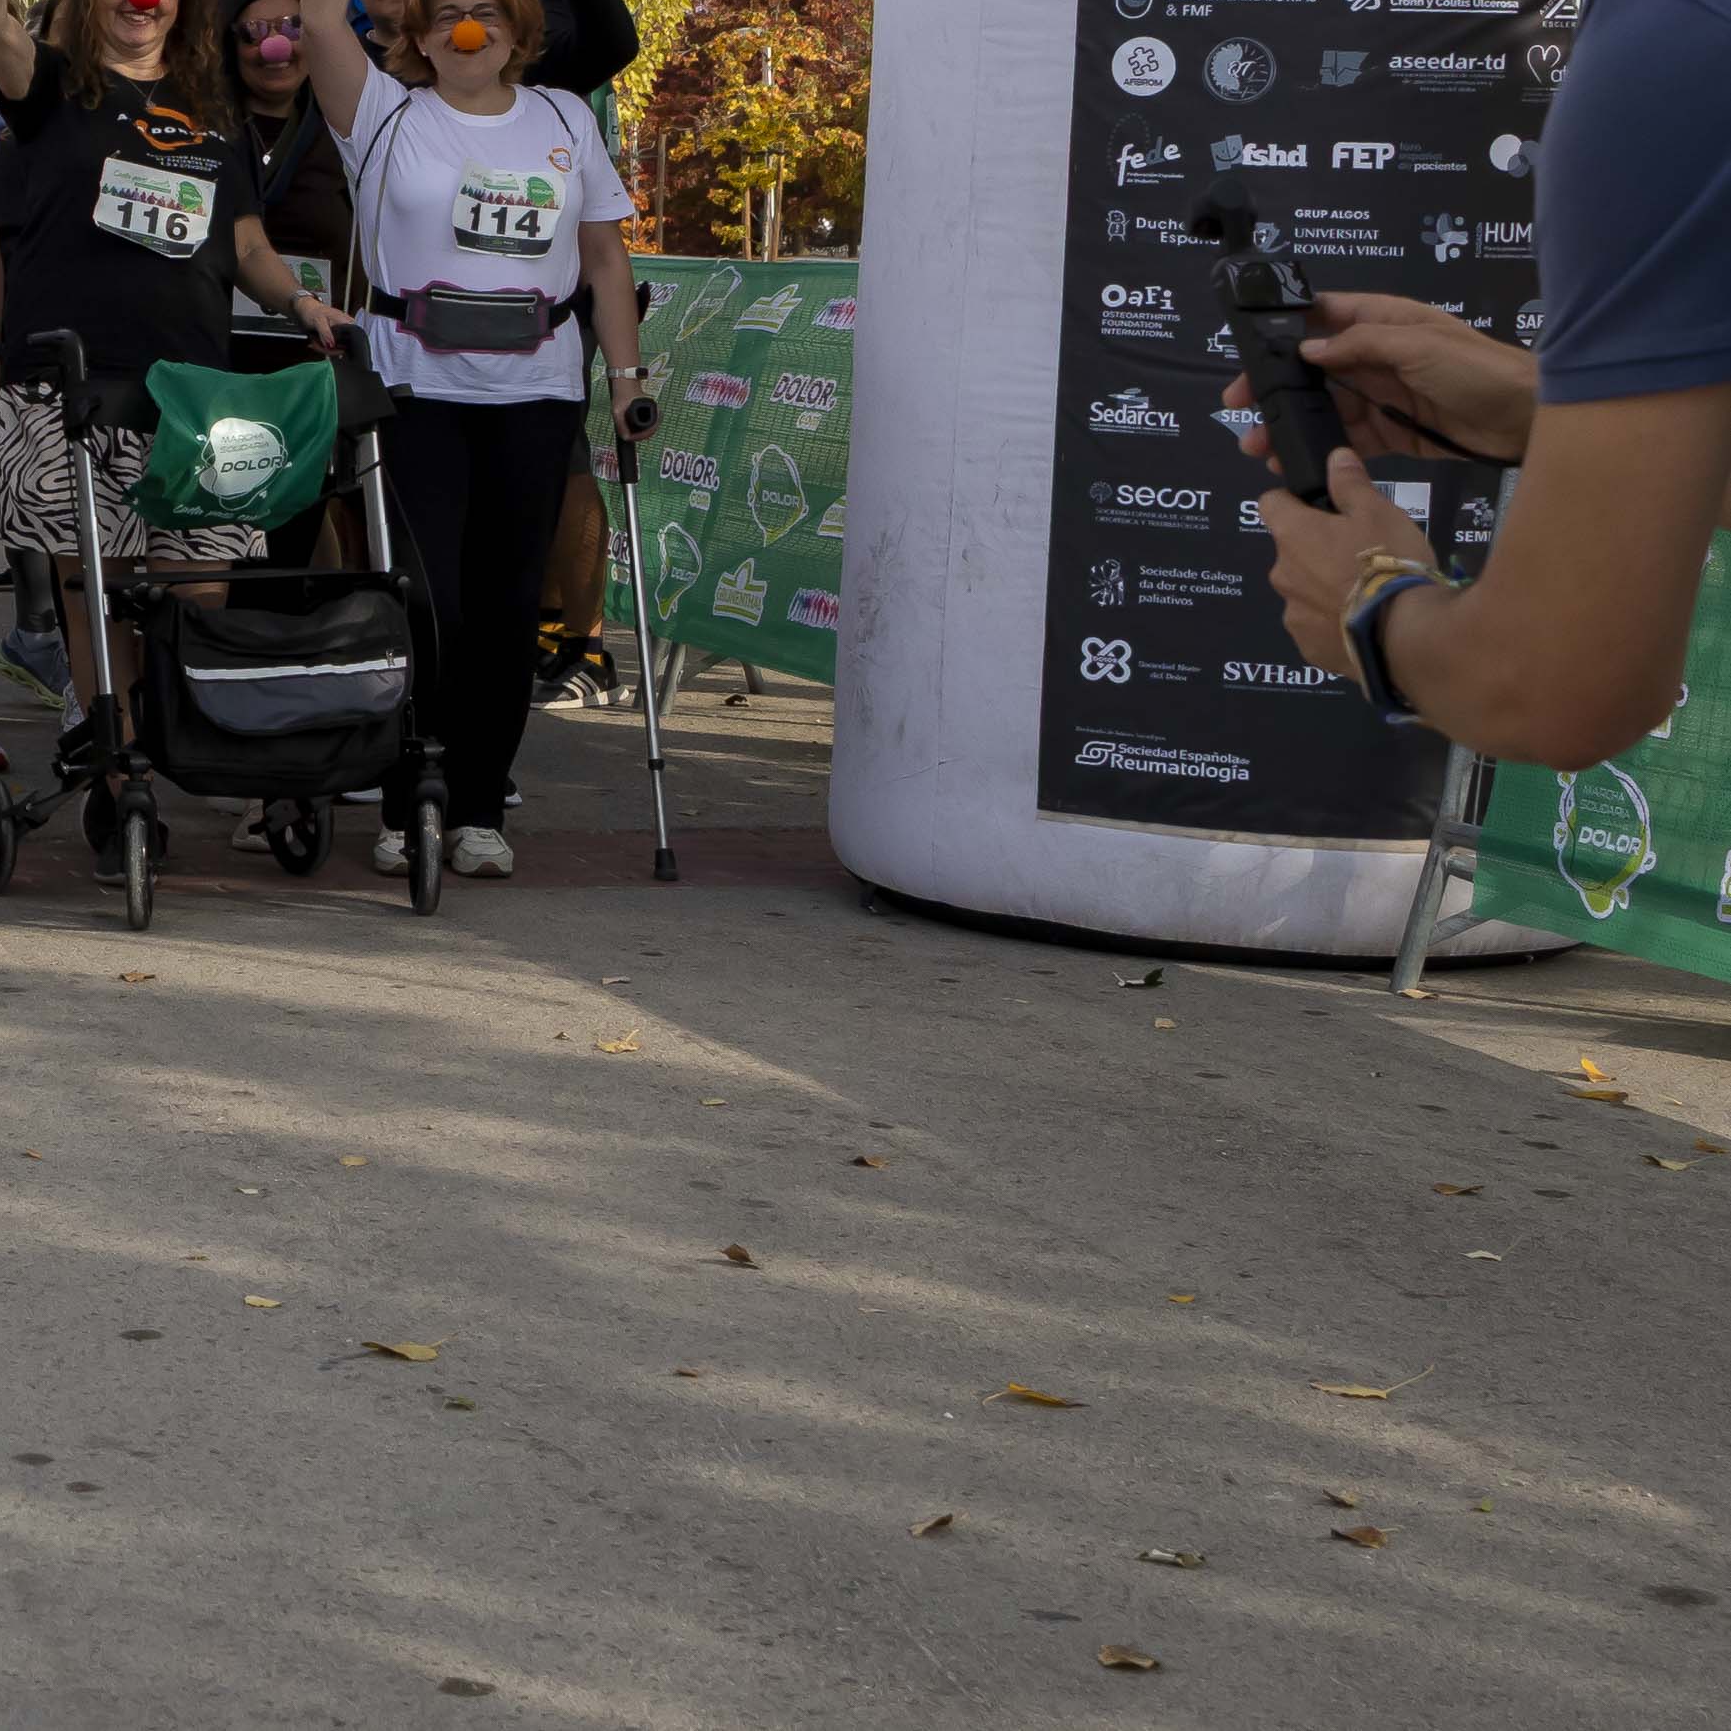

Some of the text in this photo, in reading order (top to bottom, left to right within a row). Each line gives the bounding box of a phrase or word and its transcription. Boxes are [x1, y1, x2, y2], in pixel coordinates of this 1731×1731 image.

[1166, 4, 1213, 16] & FMF
[1426, 0, 1433, 9] y
[1389, 52, 1507, 71] aseedar-td
[1117, 136, 1181, 187] fede
[1242, 143, 1308, 168] fshd
[1332, 141, 1395, 170] FEP
[1414, 162, 1468, 173] pacientes
[117, 201, 190, 241] 116
[470, 203, 541, 238] 114
[1294, 209, 1370, 220] GRUP ALGOS
[1294, 228, 1380, 240] UNIVERSITAT
[1293, 243, 1345, 255] ROVIRA
[1356, 245, 1405, 257] VIRGILI
[1101, 319, 1163, 330] FOUNDATION
[1102, 310, 1181, 322] OSTEOARTHRITIS
[1474, 316, 1492, 328] del
[1100, 327, 1175, 339] INTERNATIONAL
[220, 455, 284, 473] DOLOR
[762, 489, 800, 508] DOLOR
[1454, 530, 1491, 543] SEM
[1139, 565, 1243, 584] Sociedade Galega
[1139, 580, 1155, 590] da
[1156, 581, 1176, 592] dor
[1189, 583, 1243, 597] coidados
[1138, 594, 1194, 607] paliativos
[1223, 660, 1325, 686] SVHaD
[1118, 742, 1177, 759] Sociedad
[1179, 749, 1240, 765] Española
[1110, 753, 1250, 783] Reumatología
[1578, 825, 1642, 855] DOLOR
